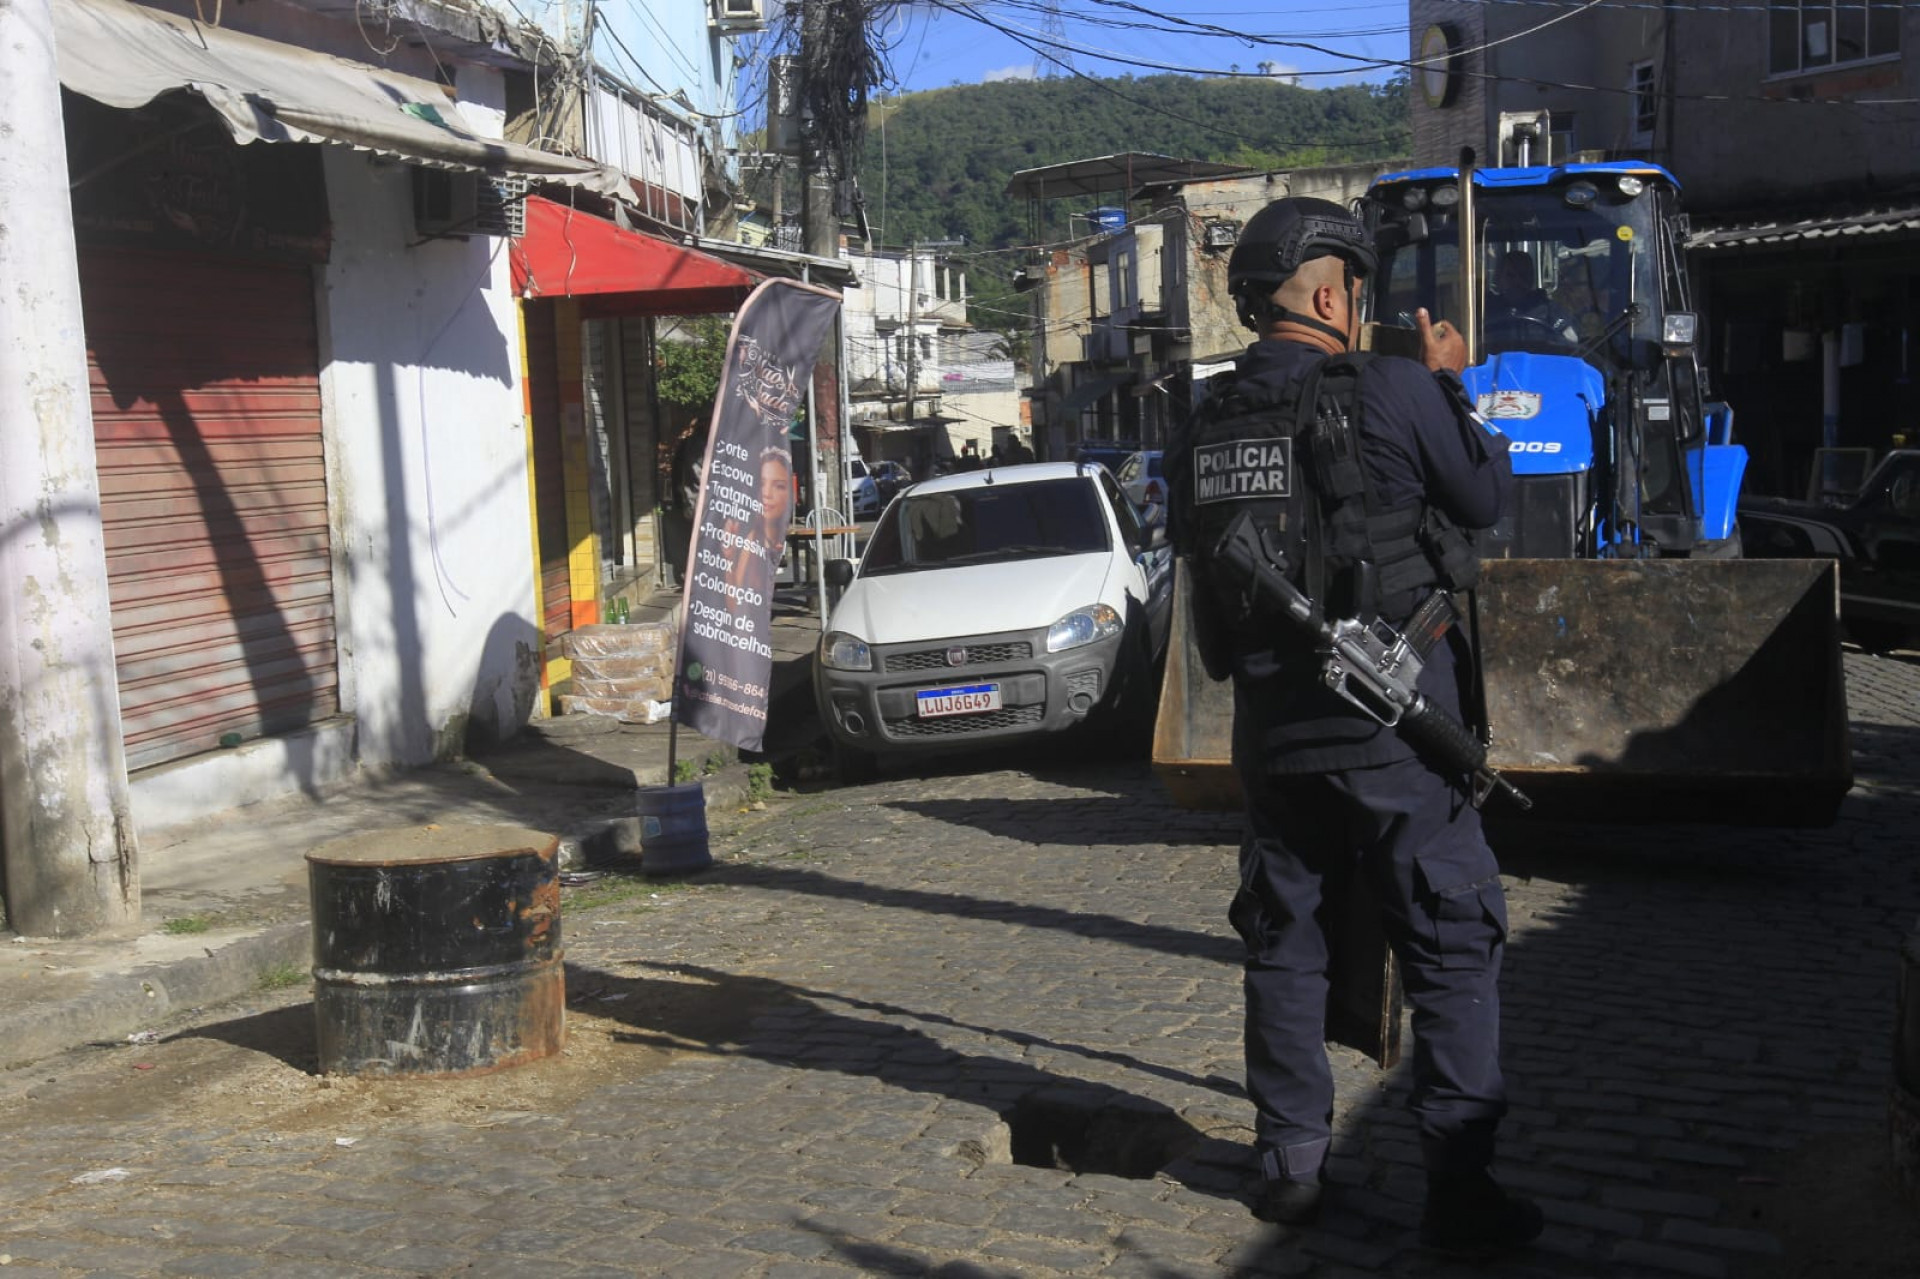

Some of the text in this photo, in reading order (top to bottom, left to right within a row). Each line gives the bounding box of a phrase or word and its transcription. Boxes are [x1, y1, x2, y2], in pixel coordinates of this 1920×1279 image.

[711, 459, 754, 487] Escova
[1200, 443, 1285, 475] POLÍCIA
[1200, 469, 1285, 499] MILITAR
[702, 548, 734, 572] Botox
[698, 572, 763, 606] Coloração
[694, 600, 755, 632] Desgin de
[693, 621, 773, 659] sobrancelhas
[924, 693, 991, 714] LUJ6G49
